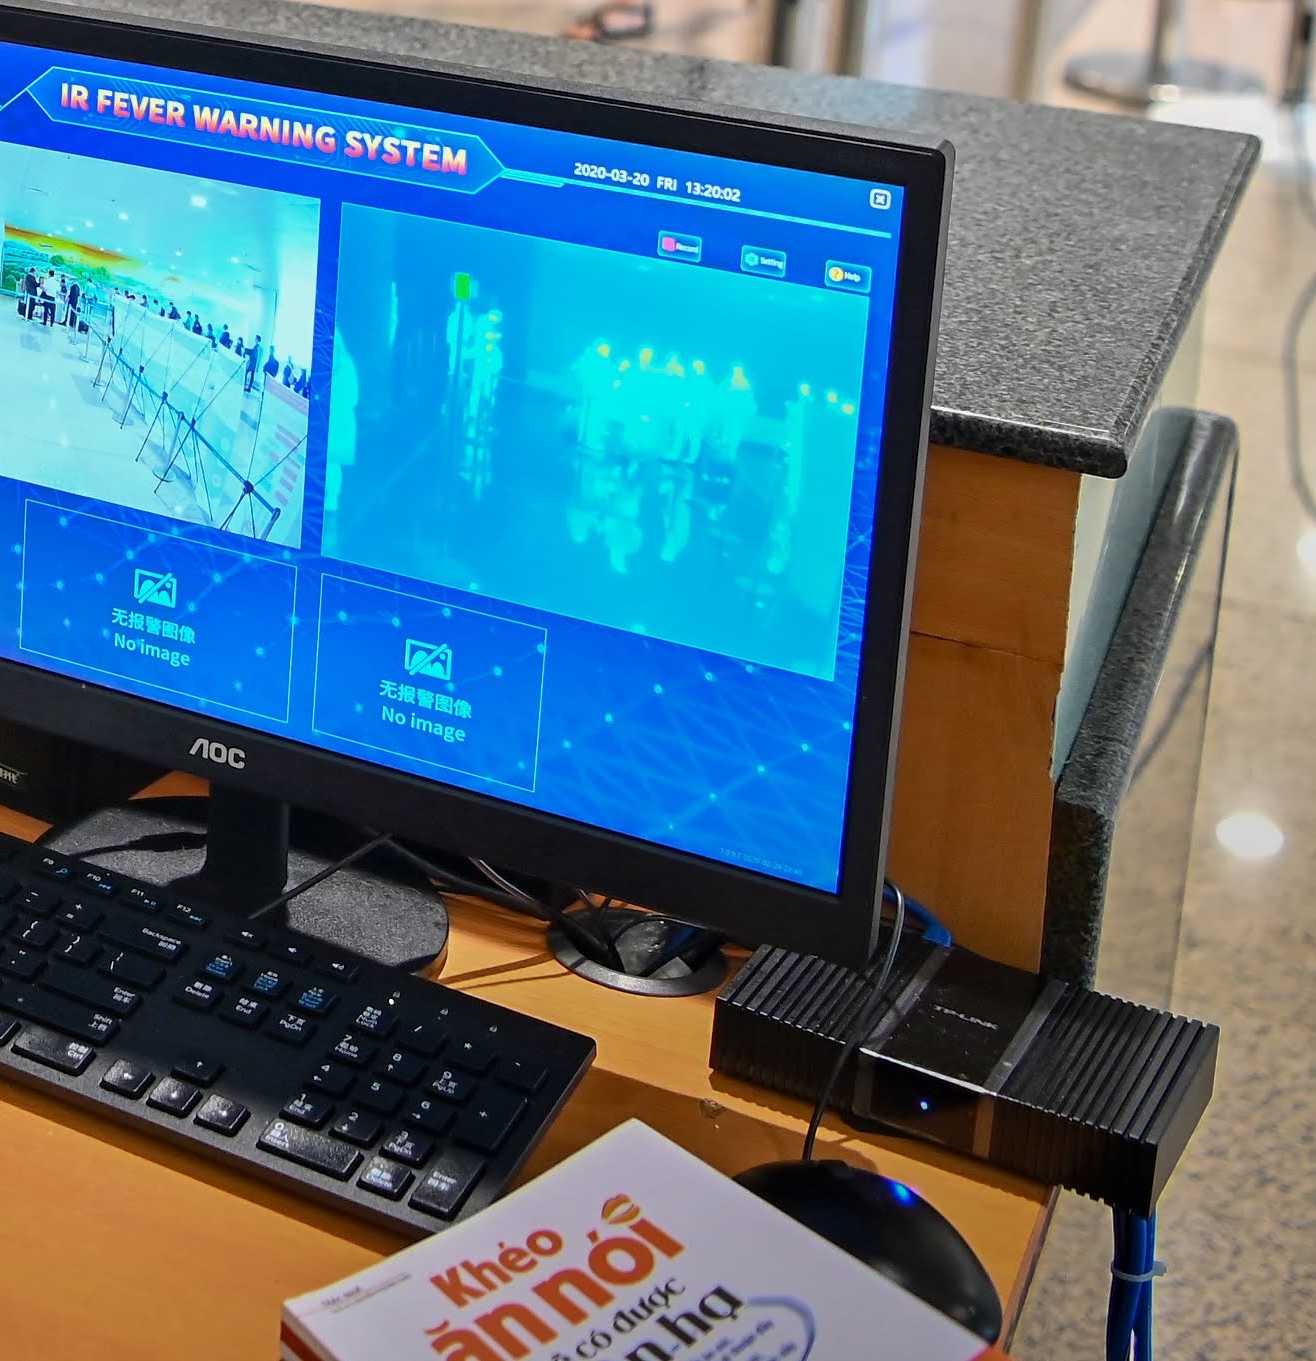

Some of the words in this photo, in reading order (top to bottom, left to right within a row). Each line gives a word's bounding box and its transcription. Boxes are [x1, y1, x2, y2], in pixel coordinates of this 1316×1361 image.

[61, 82, 89, 111] IR
[97, 90, 185, 128] FEVER
[193, 104, 335, 154] WARNING
[343, 130, 467, 176] SYSTEM
[573, 162, 650, 187] 2020-03-20
[656, 177, 678, 192] FRI
[685, 180, 741, 203] 13:20:02
[675, 242, 699, 254] Record
[844, 271, 861, 283] Help
[112, 608, 196, 644] 无报警图像
[114, 633, 136, 651] No
[140, 638, 191, 667] image
[379, 679, 472, 719] 无报警图像
[382, 706, 406, 725] No
[410, 713, 466, 743] image
[189, 738, 246, 769] AOC
[141, 926, 182, 946] Backspace
[184, 985, 211, 1000] Delete
[235, 1004, 253, 1016] End
[933, 1004, 998, 1030] TP-LINK
[429, 1229, 564, 1309] Khéo
[531, 1217, 685, 1326] nói
[575, 1329, 612, 1359] có
[612, 1277, 686, 1333] được
